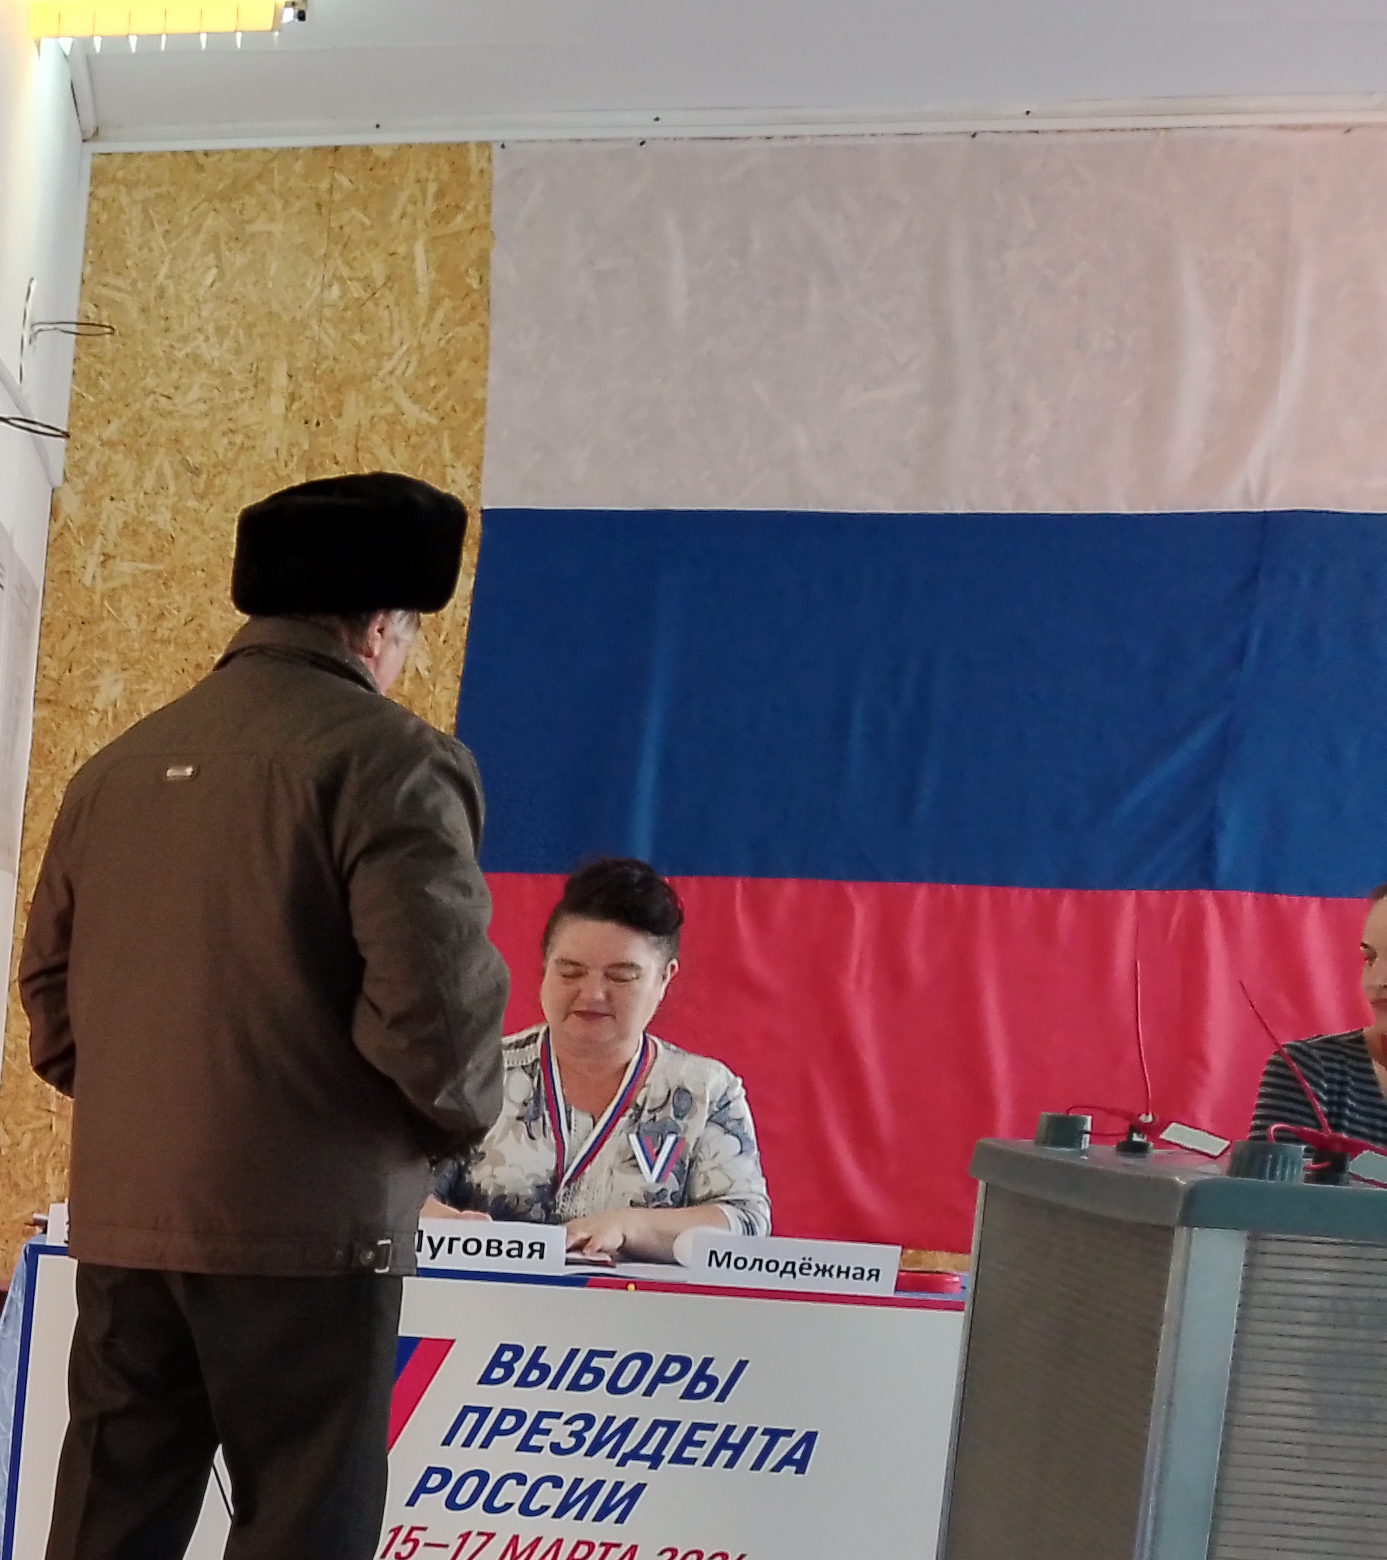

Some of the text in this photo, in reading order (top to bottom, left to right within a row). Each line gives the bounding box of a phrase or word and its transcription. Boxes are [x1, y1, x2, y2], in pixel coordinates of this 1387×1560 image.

[707, 1248, 882, 1284] Молодёжная
[477, 1341, 751, 1405] ВЫБОРЫ
[440, 1404, 821, 1476] ПРЕЗИДЕНТА
[404, 1466, 648, 1525] РОССИИ
